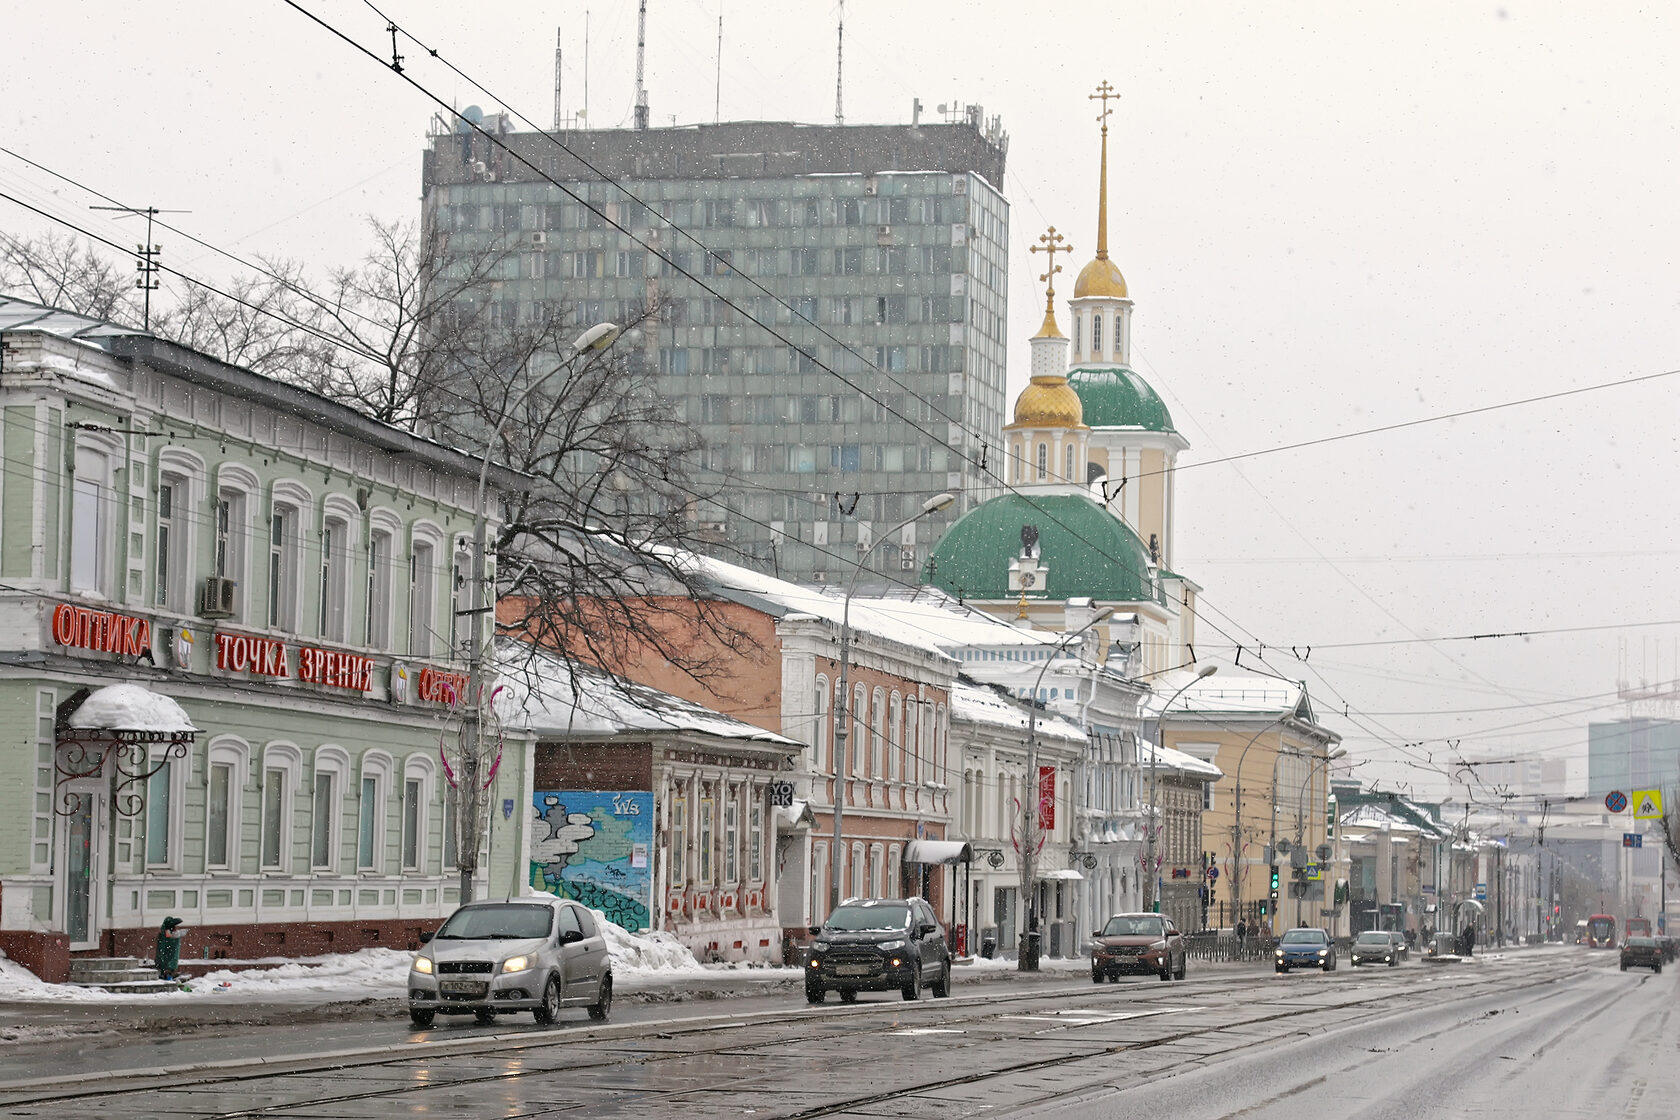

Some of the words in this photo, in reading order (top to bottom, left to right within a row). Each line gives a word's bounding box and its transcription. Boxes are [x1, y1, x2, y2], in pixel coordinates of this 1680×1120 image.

[53, 603, 152, 657] ОПТИКА
[216, 632, 290, 677] ТОЧКА
[299, 648, 375, 691] ЗРЕНИЯ
[772, 784, 792, 795] YO
[772, 795, 791, 805] RK
